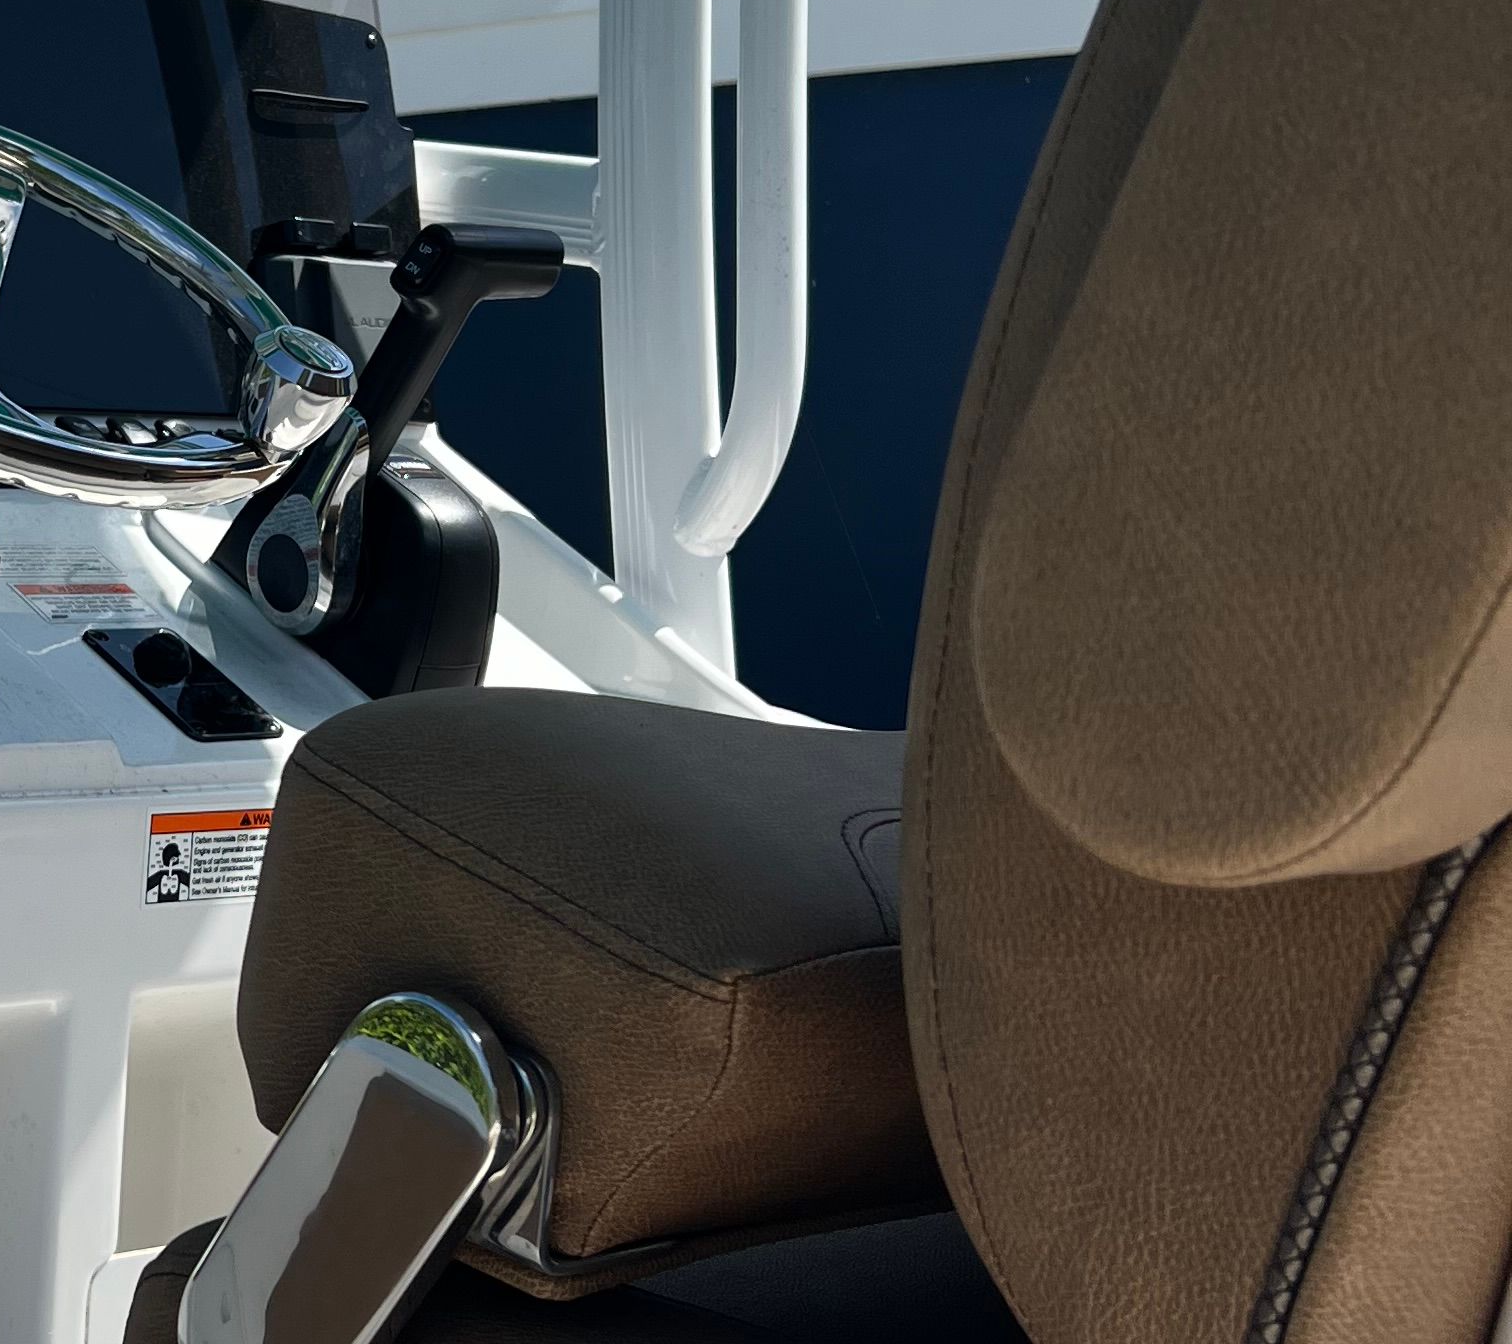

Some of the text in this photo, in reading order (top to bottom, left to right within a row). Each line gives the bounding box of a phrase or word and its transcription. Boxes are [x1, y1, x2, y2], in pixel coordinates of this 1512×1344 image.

[418, 242, 433, 255] UP
[404, 261, 421, 275] DN
[360, 317, 391, 328] AUD
[253, 813, 271, 825] WA
